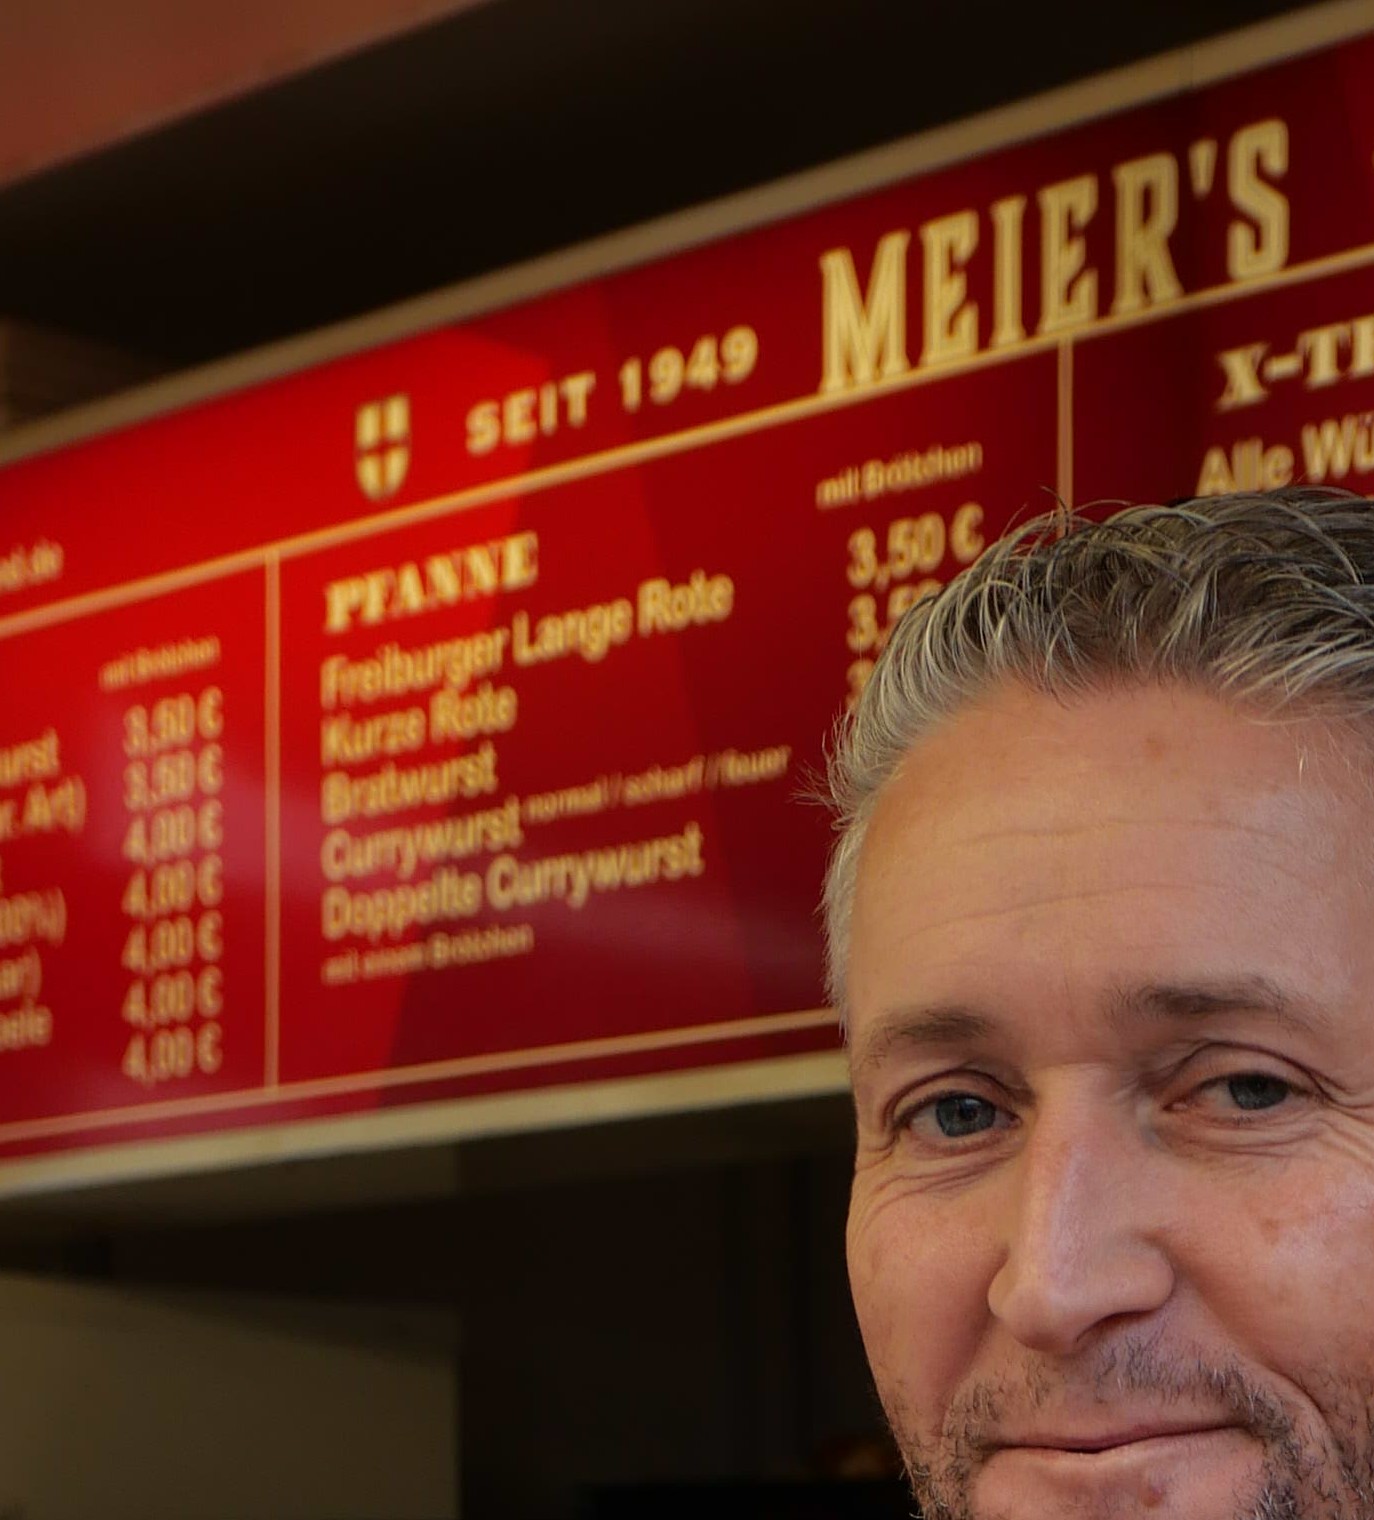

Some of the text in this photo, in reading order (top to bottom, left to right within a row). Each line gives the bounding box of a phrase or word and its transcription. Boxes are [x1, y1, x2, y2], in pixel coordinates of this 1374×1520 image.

[818, 120, 1290, 398] MEIER'S
[465, 325, 759, 456] SEIT 1949
[1196, 436, 1295, 497] Alle
[324, 530, 538, 635] PFANNE
[846, 501, 985, 592] 3,50 €
[320, 568, 735, 711] Freiburger Lange Rote
[320, 680, 518, 768] Kurze Rote
[320, 740, 498, 826] Bratwurst
[320, 795, 524, 881] Currywurst
[320, 821, 706, 943] Doppelte Currywurst
